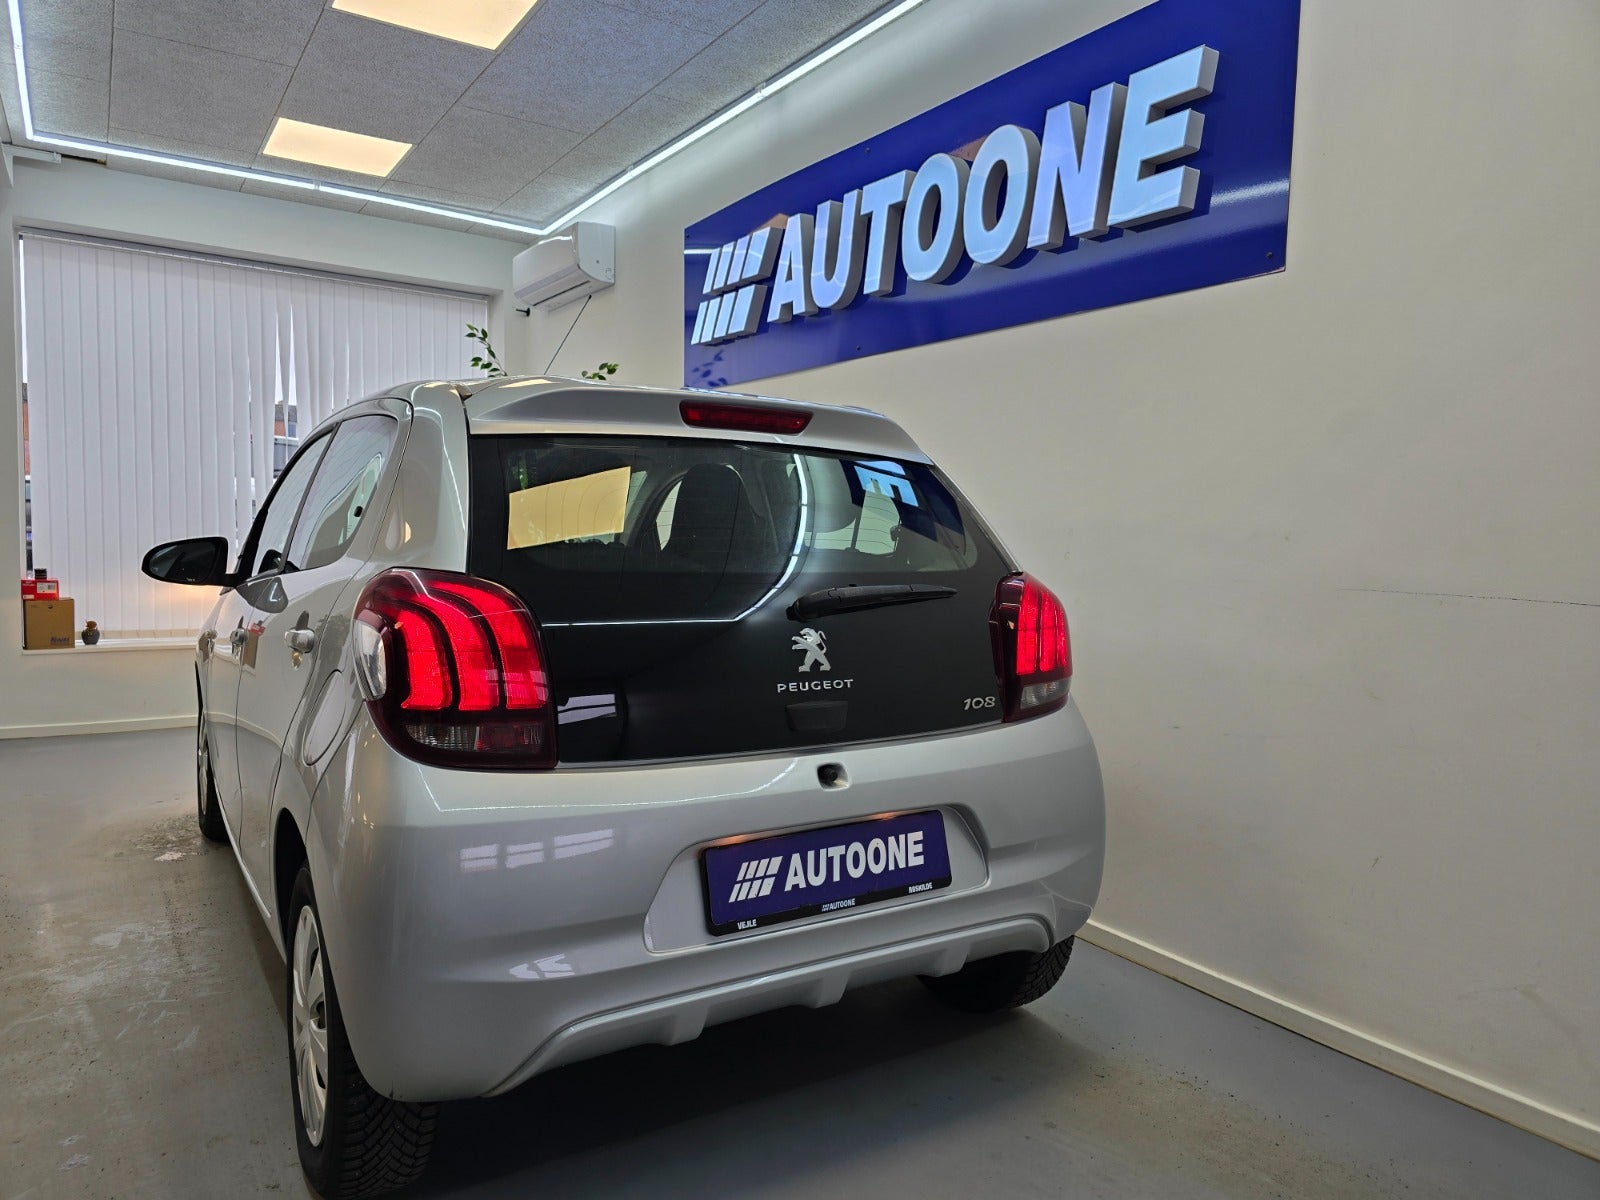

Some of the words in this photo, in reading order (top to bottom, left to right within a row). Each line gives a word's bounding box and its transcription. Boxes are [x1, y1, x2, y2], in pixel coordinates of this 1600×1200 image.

[767, 44, 1220, 323] AUTOONE
[777, 679, 854, 693] PEUGEOT
[963, 696, 996, 711] 108
[784, 830, 925, 892] AUTOONE
[829, 897, 856, 911] AUTOONE
[737, 918, 757, 930] VEJLE
